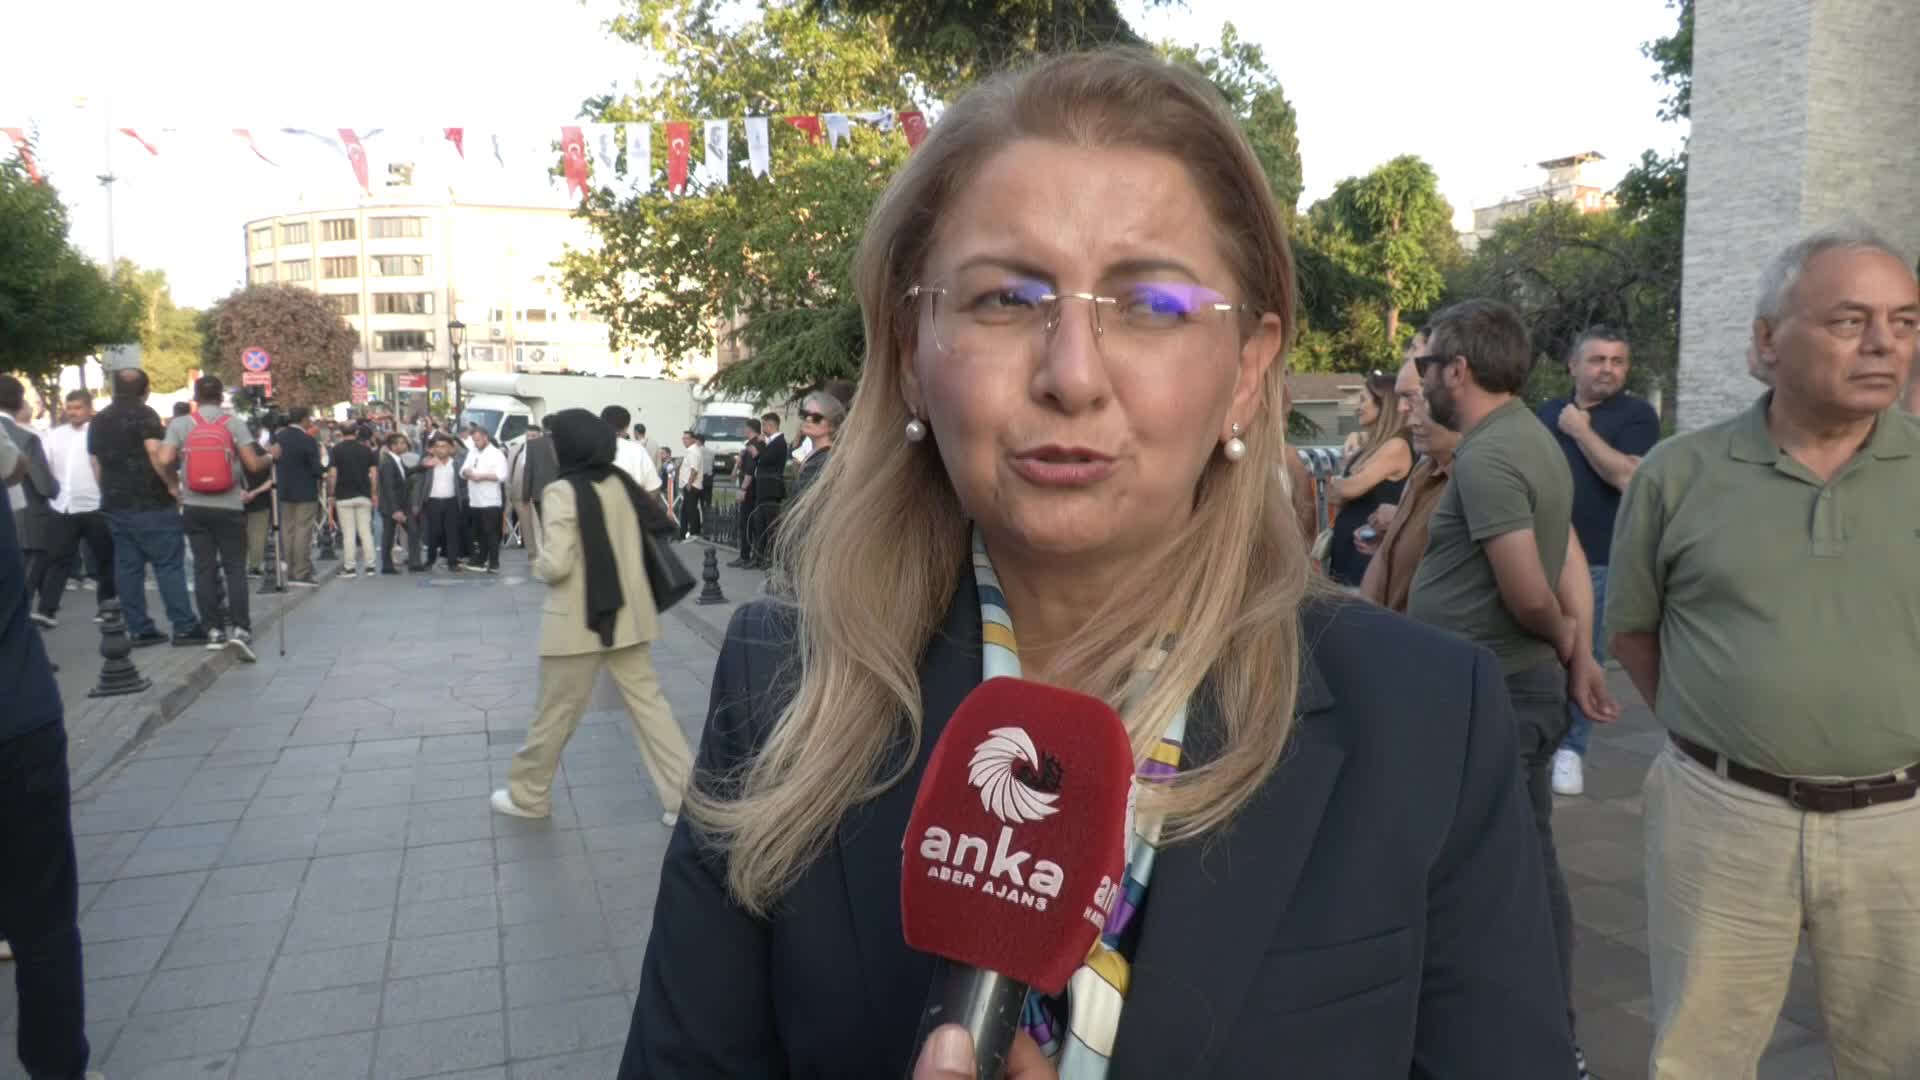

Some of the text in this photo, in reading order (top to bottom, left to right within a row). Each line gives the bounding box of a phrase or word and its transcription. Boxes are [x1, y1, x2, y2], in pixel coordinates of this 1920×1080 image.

[920, 825, 1064, 898] anka
[927, 865, 1049, 912] ABER AJANS
